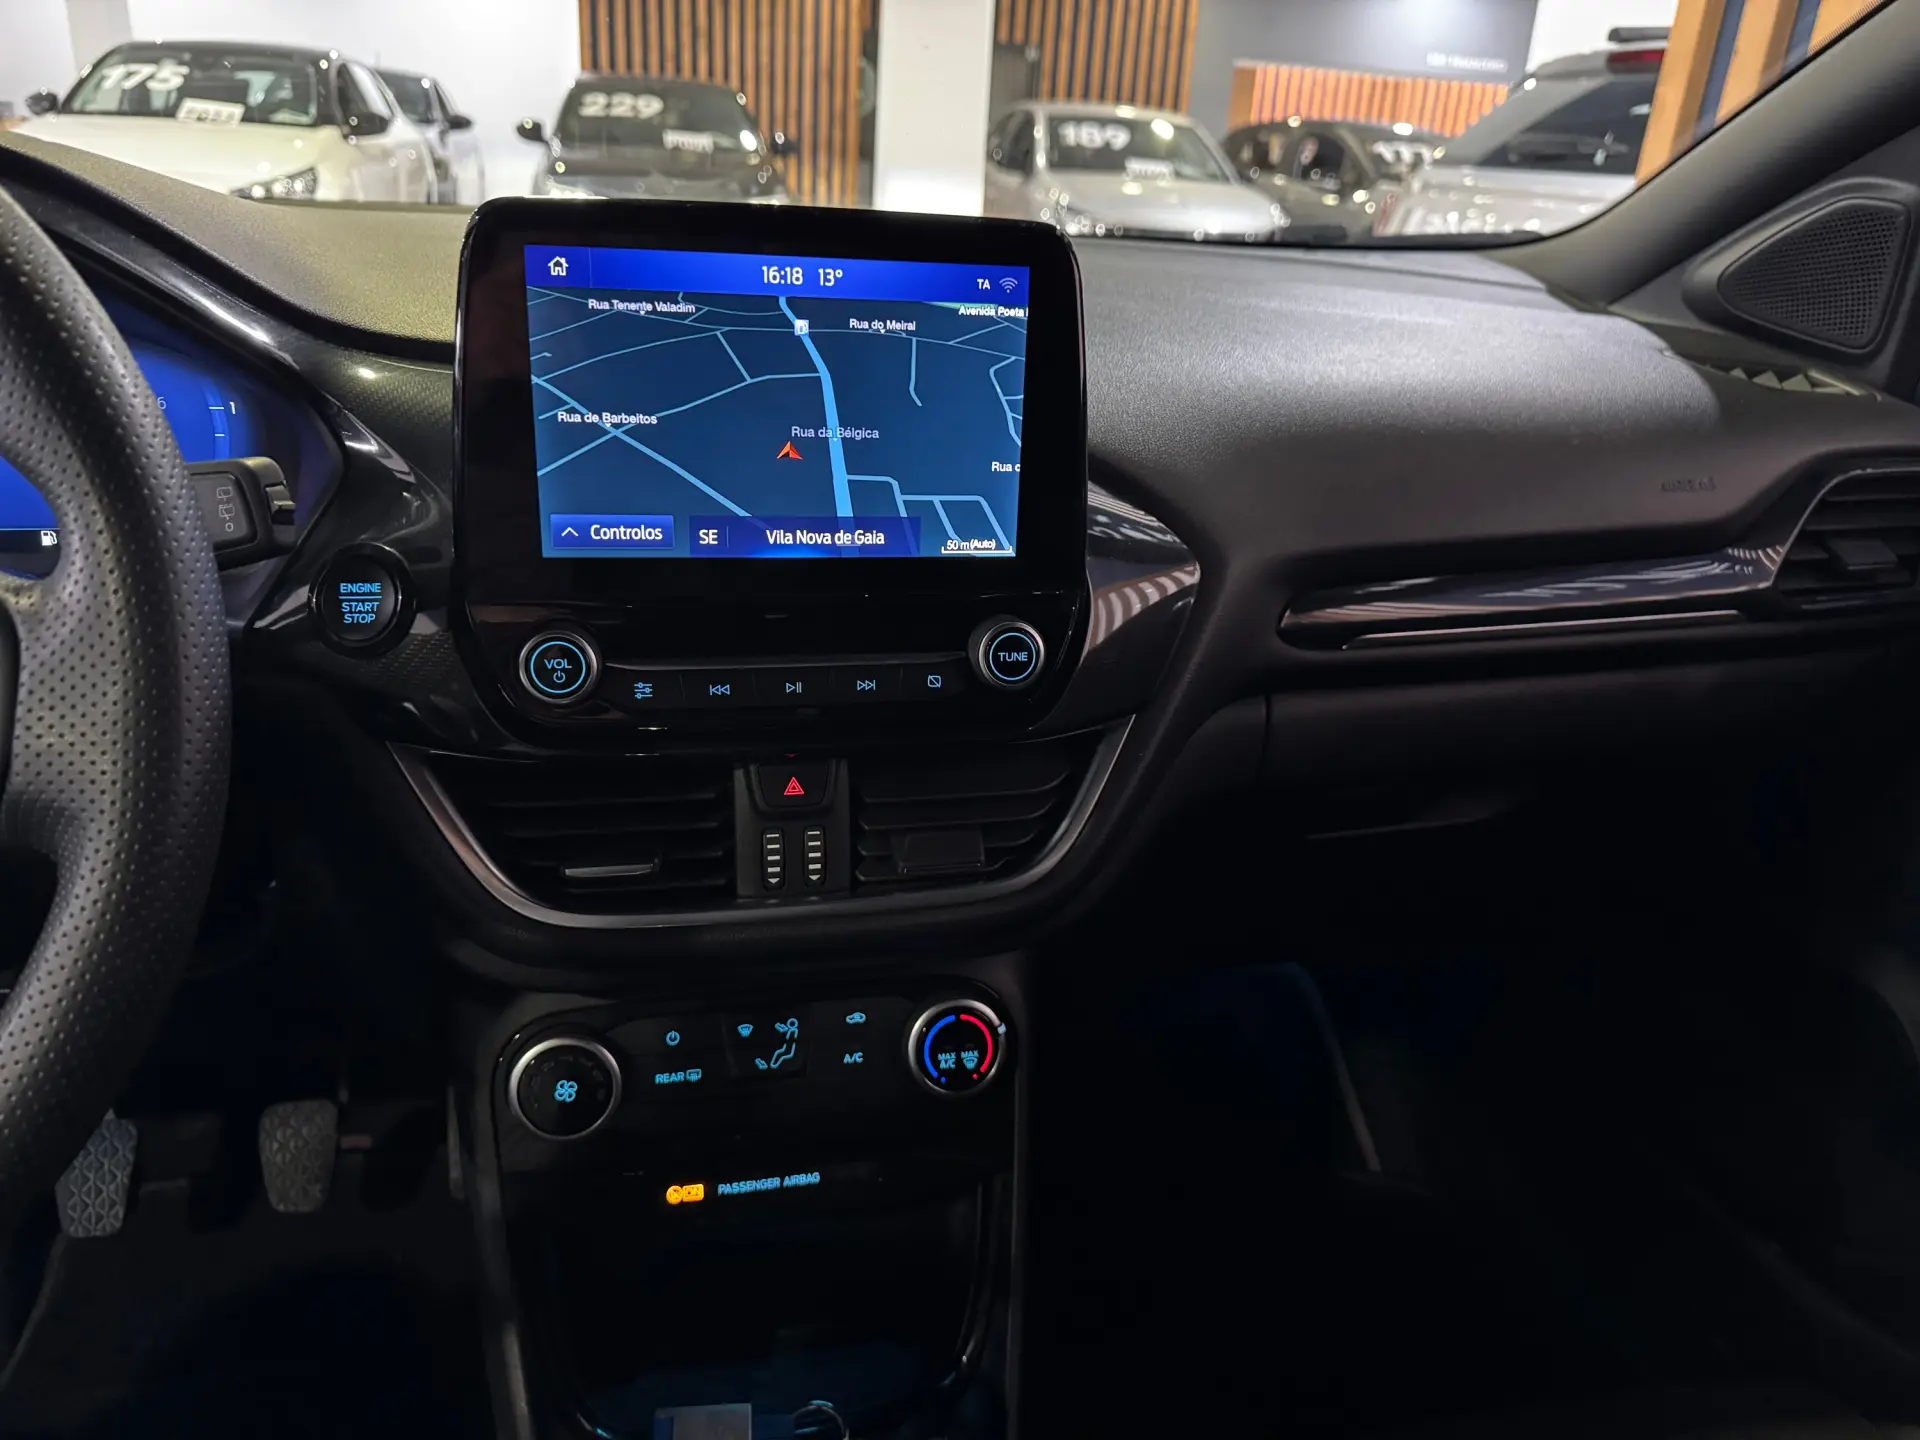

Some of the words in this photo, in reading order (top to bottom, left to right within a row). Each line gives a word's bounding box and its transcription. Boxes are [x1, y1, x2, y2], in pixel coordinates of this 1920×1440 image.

[578, 91, 664, 119] 229
[761, 265, 804, 286] 16:18
[818, 268, 844, 287] 13°
[977, 278, 991, 290] TA
[588, 299, 609, 310] Rua
[611, 299, 653, 313] Tenente
[656, 301, 696, 314] Valadim
[958, 305, 995, 317] Avenida
[998, 306, 1025, 318] Poeta
[849, 318, 870, 331] Rua
[871, 320, 884, 331] do
[886, 320, 916, 332] Meiral
[558, 411, 582, 424] Rua
[584, 412, 600, 424] de
[602, 412, 658, 425] Barbeitos
[791, 426, 815, 438] Rua
[818, 427, 833, 438] da
[836, 427, 880, 440] Bélgica
[991, 462, 1013, 473] Rua
[590, 524, 663, 540] Controlos
[698, 529, 718, 545] SE
[766, 529, 794, 545] Vila
[796, 529, 832, 545] Nova
[834, 529, 852, 545] de
[854, 529, 885, 545] Gaia
[946, 539, 958, 550] 50
[340, 582, 382, 593] ENGINE
[341, 601, 380, 612] START
[343, 613, 376, 624] STOP
[997, 651, 1028, 662] TUNE
[543, 658, 573, 669] VOL
[843, 1052, 864, 1064] A/C
[937, 1052, 956, 1061] MAX
[960, 1050, 979, 1058] MAX
[939, 1059, 956, 1069] A/C
[654, 1071, 685, 1085] REAR
[717, 1177, 781, 1196] PASSENGER
[783, 1171, 821, 1187] AIRBAG
